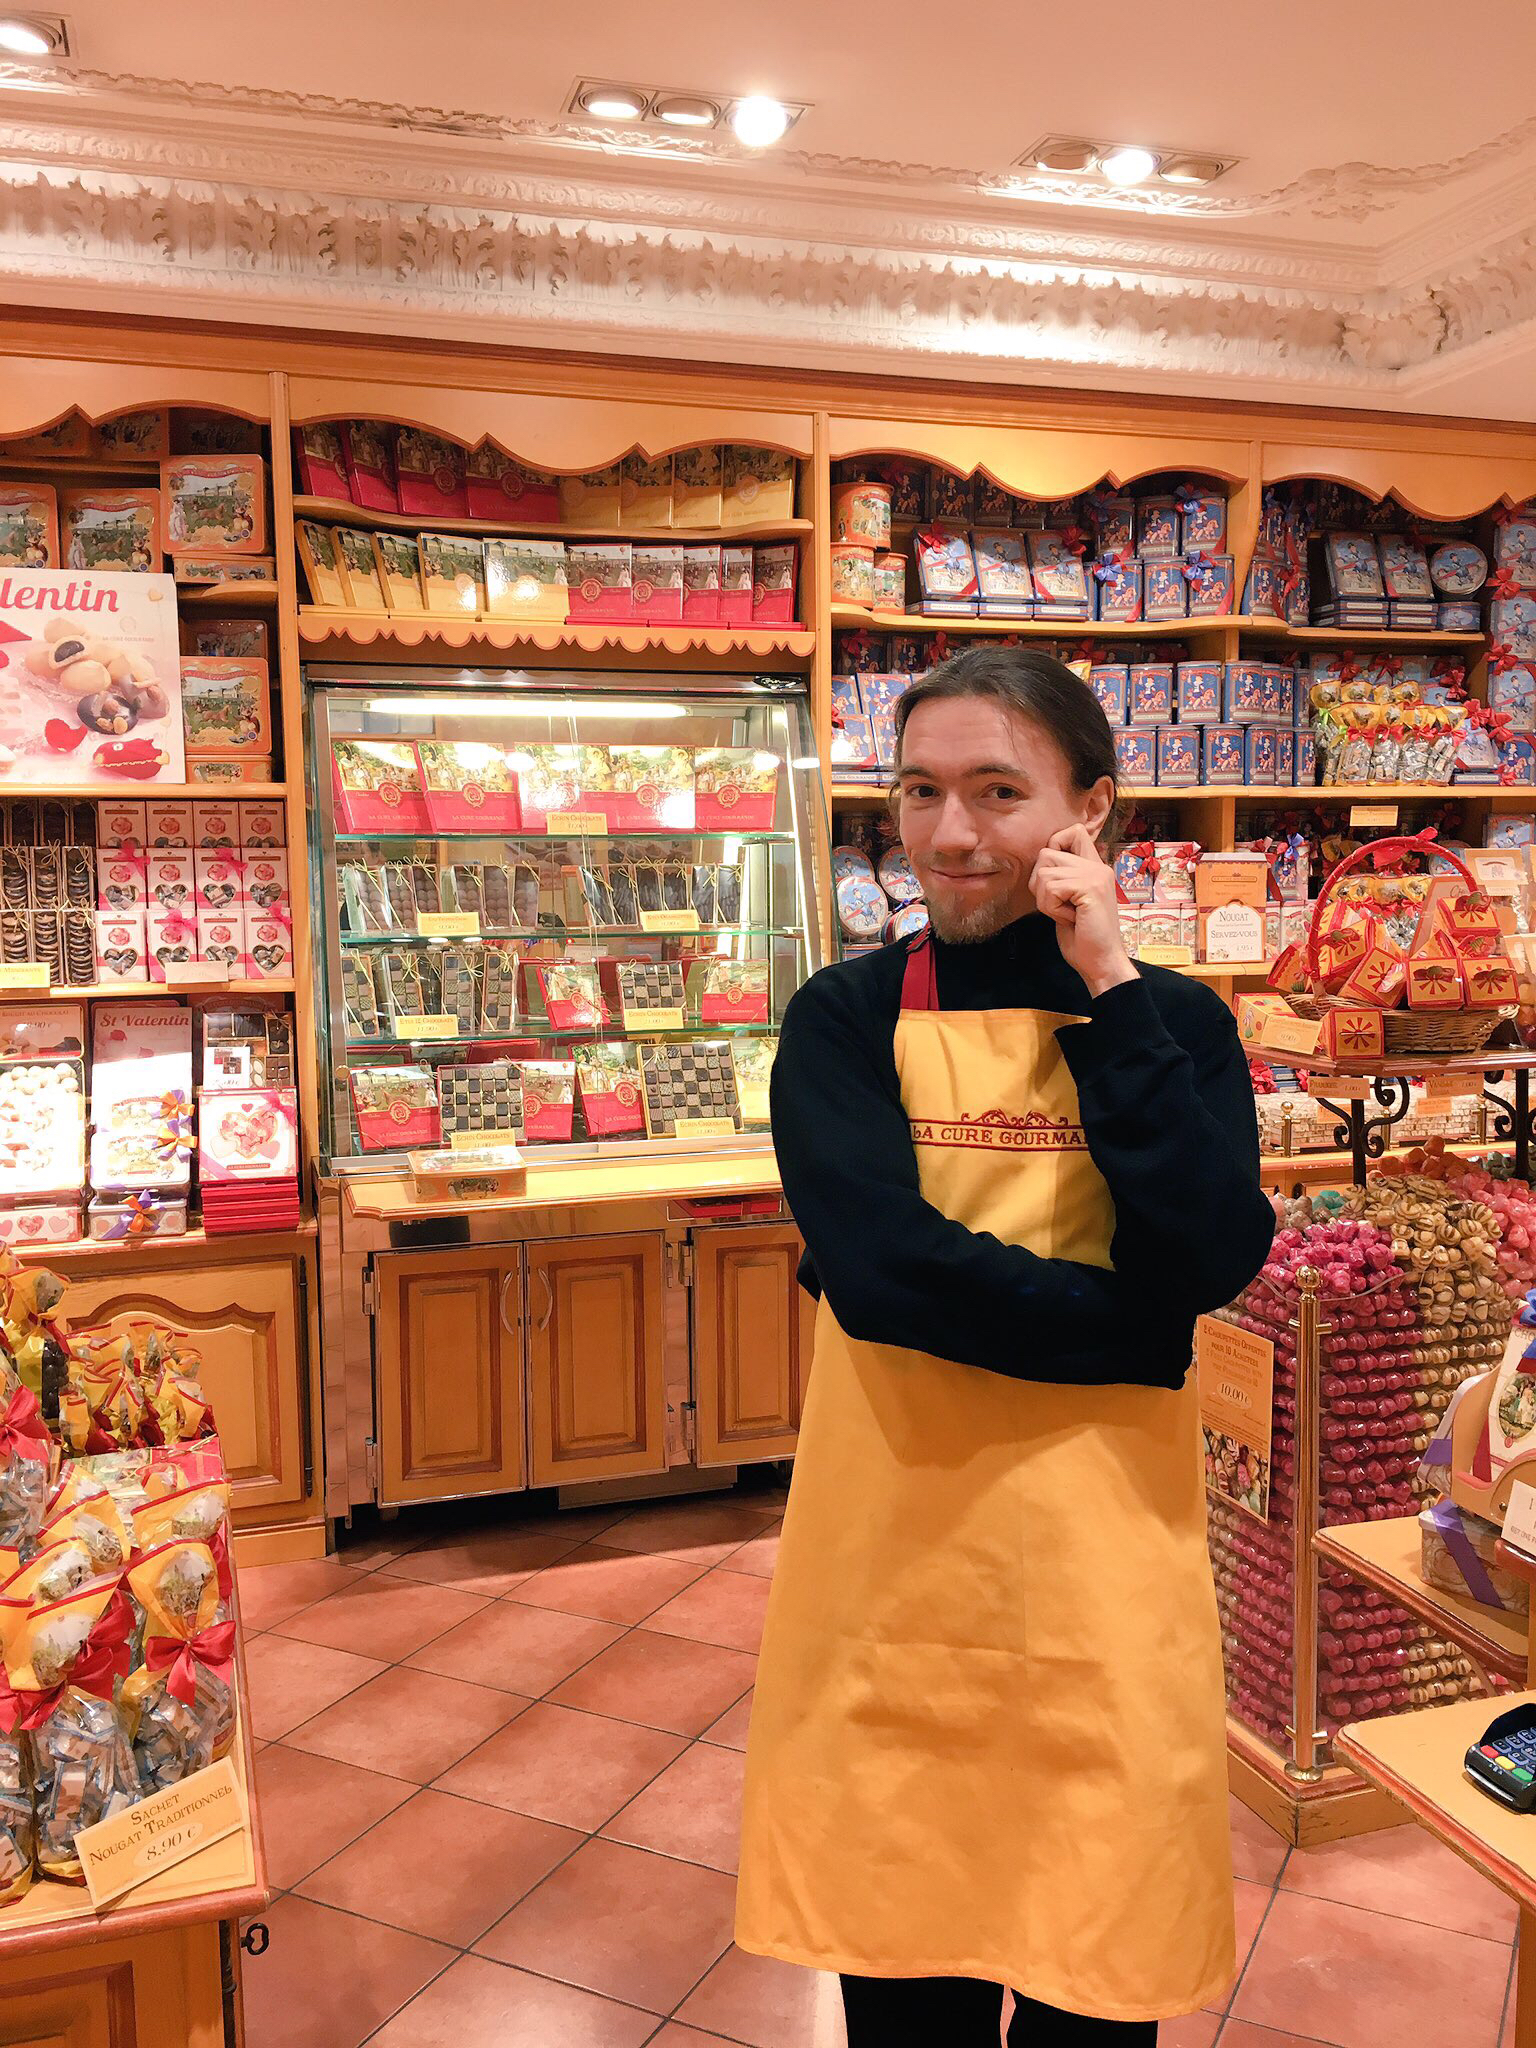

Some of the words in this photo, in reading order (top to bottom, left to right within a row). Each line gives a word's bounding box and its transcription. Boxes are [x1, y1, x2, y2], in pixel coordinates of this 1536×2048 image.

[100, 1014, 116, 1028] St
[121, 1013, 190, 1027] Valentin
[913, 1125, 934, 1140] LA
[941, 1127, 993, 1143] CURE
[999, 1131, 1088, 1146] GOURMA
[1220, 1383, 1244, 1402] 10.00
[130, 1793, 180, 1827] SACHET
[88, 1830, 143, 1867] NOUGAT
[143, 1785, 233, 1836] TRADITIONNEL
[146, 1832, 182, 1861] 8.90
